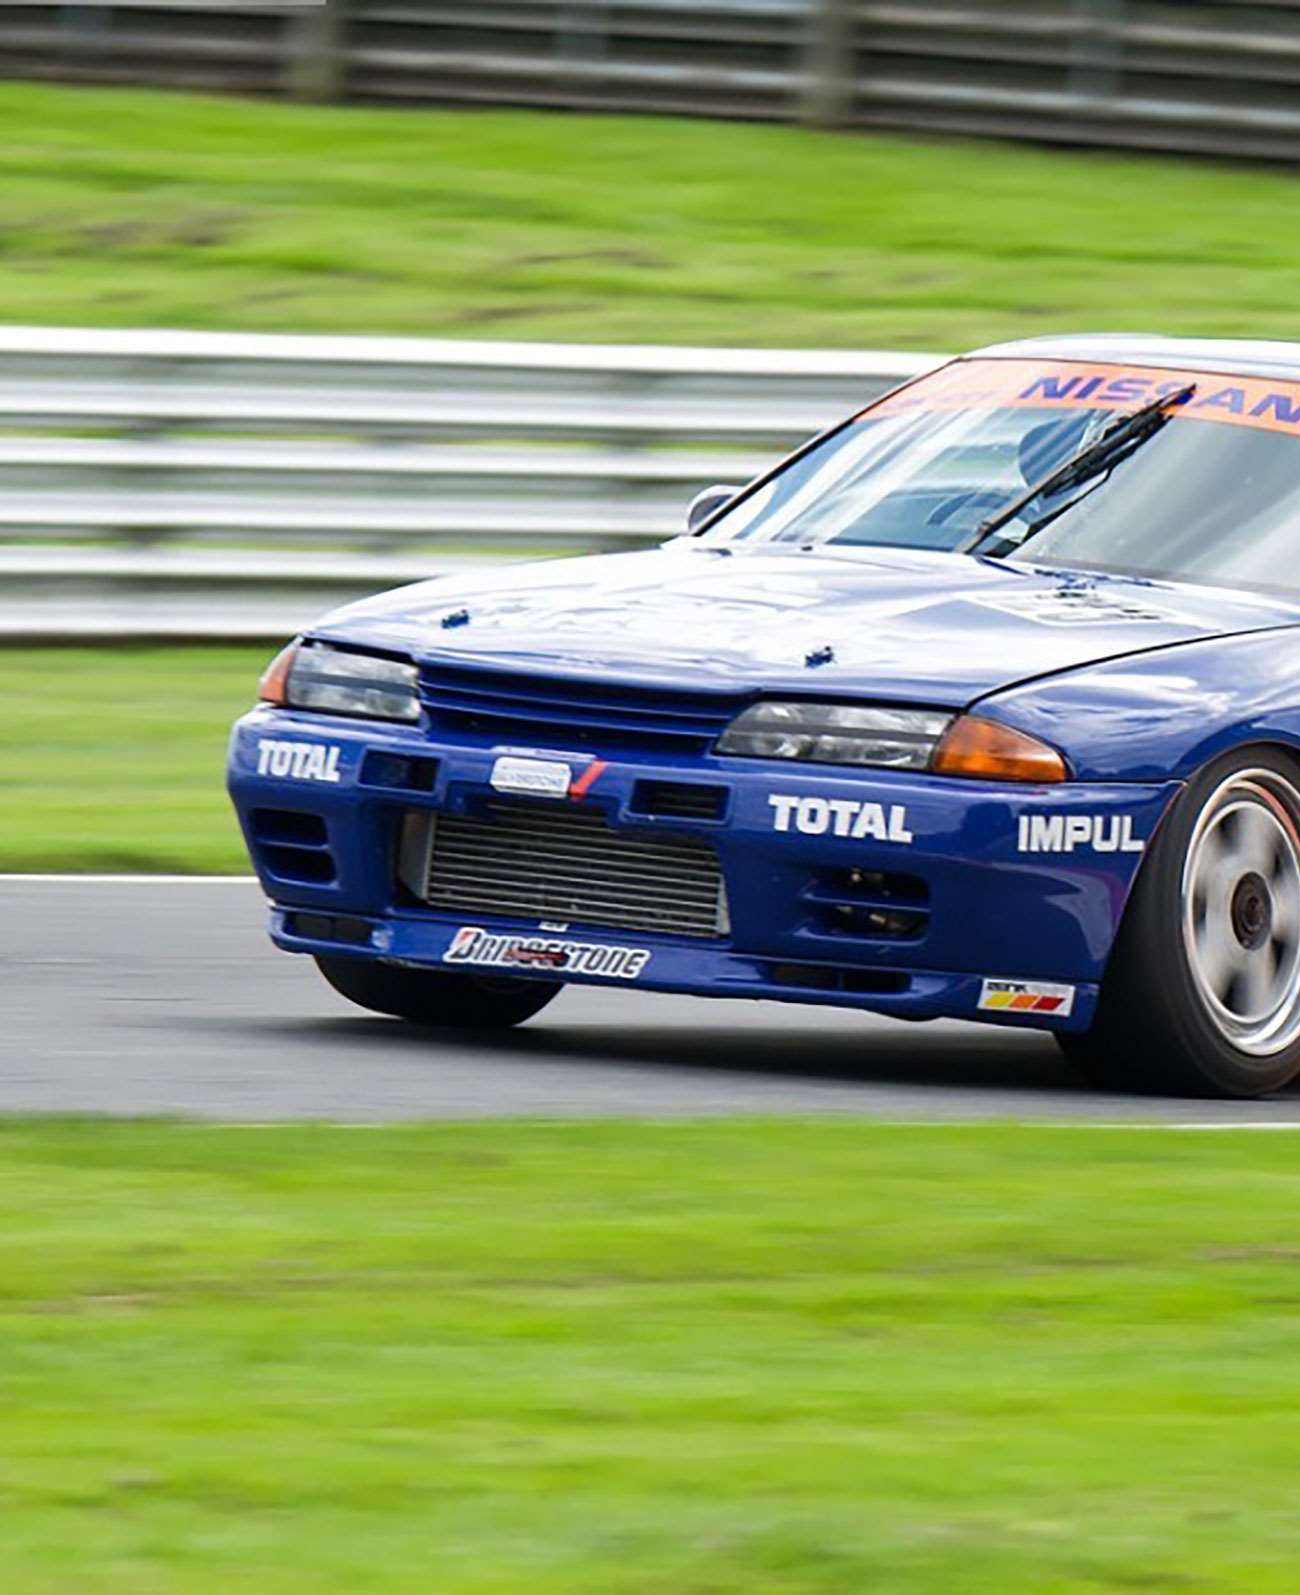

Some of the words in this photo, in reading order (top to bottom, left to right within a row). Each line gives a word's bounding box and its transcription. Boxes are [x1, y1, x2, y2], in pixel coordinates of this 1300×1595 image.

[257, 739, 341, 783] TOTAL
[768, 794, 913, 844] TOTAL
[1017, 815, 1146, 852] IMPUL
